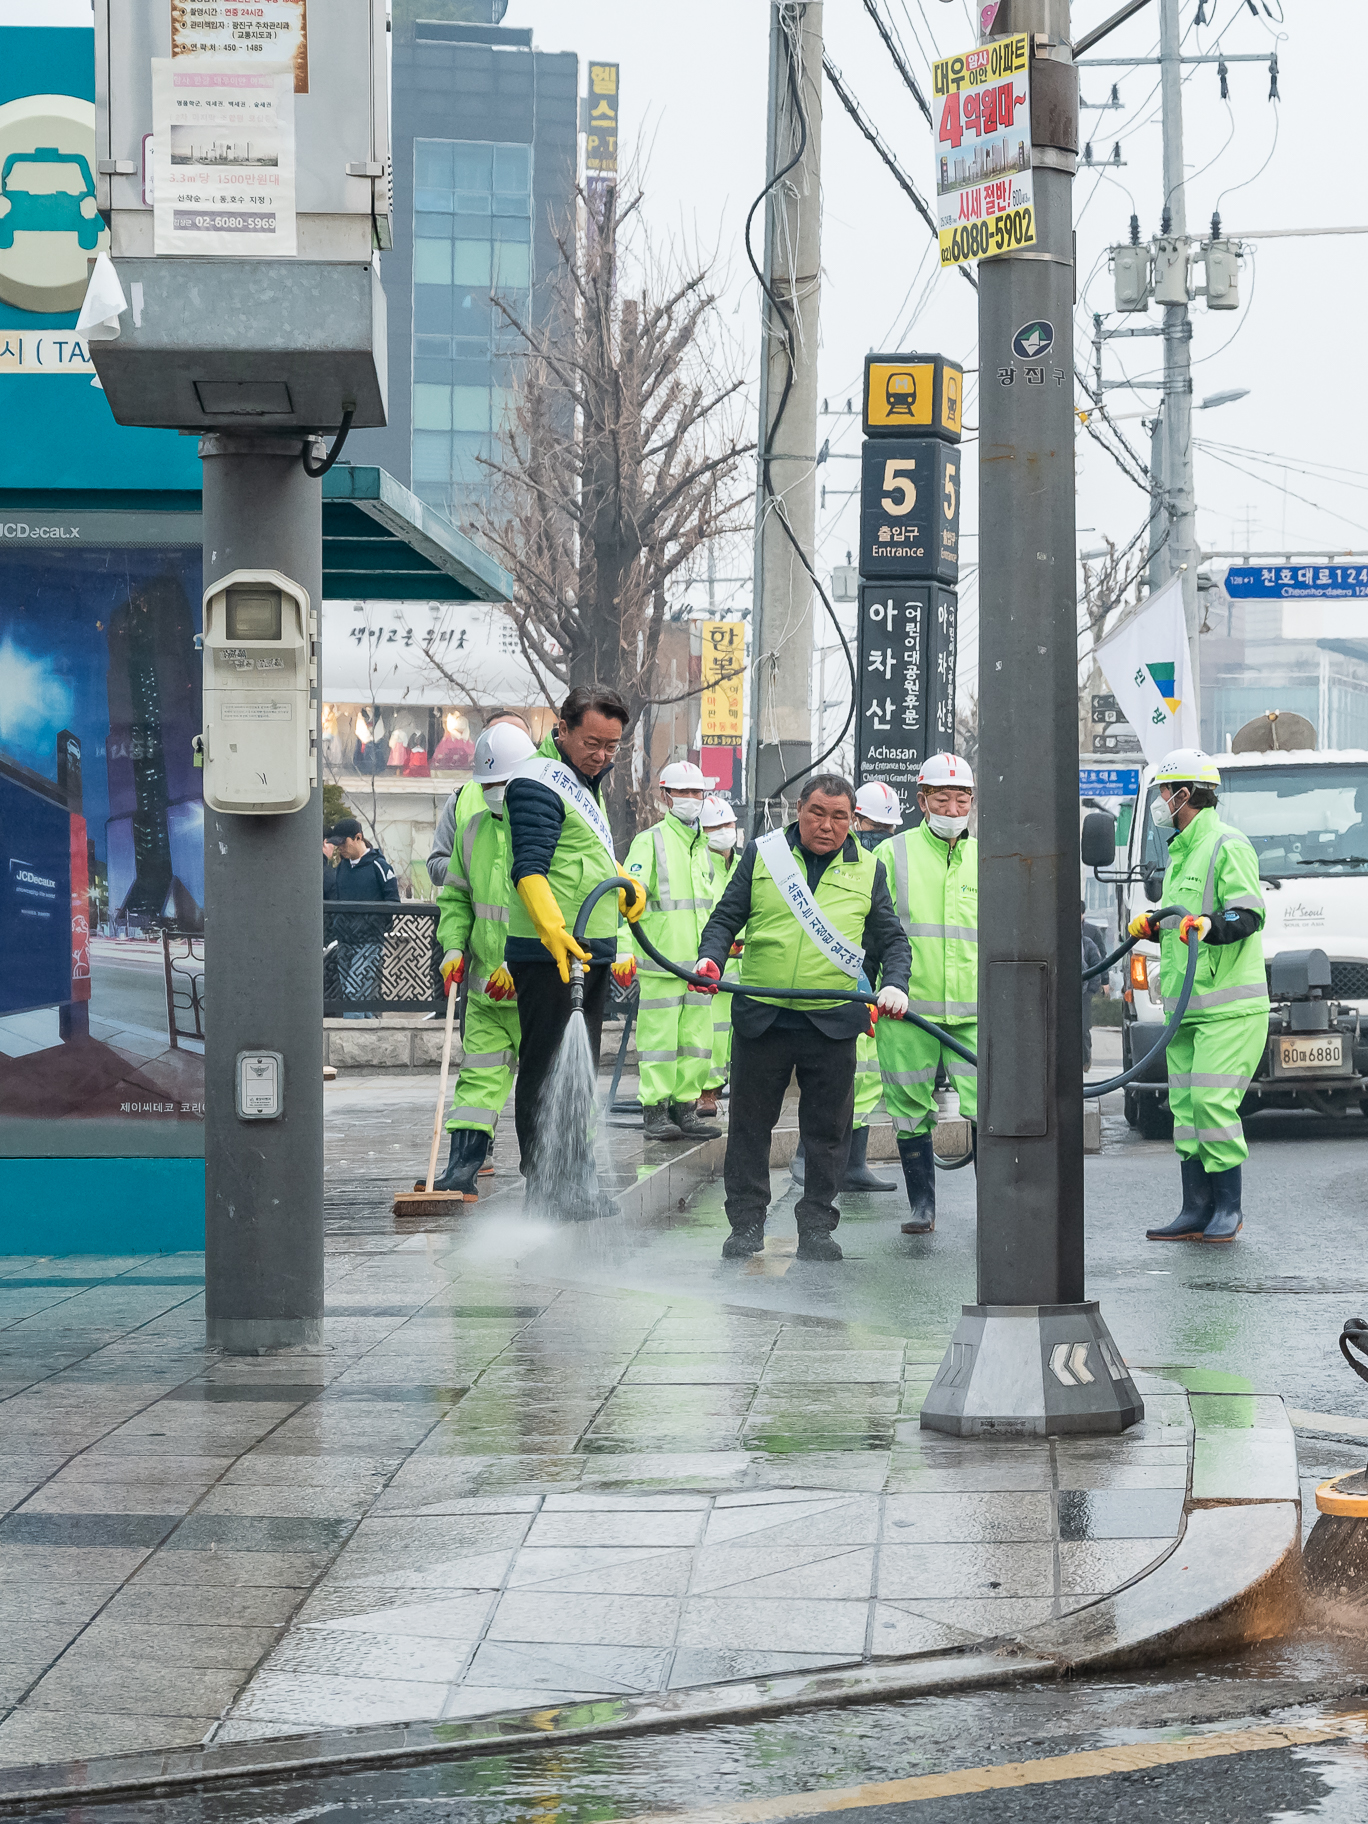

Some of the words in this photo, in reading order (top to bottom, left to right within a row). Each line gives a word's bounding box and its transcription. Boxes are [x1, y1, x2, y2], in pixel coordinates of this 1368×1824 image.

[190, 8, 217, 16] 촬영시간
[241, 8, 264, 17] 24시간
[255, 22, 290, 30] 주차관리과
[968, 51, 987, 69] 암사
[991, 37, 1025, 77] 아파트
[934, 57, 965, 95] 대우
[969, 67, 987, 85] 이안
[217, 174, 280, 186] 1500만원대
[958, 188, 981, 221] 시세
[984, 179, 1012, 216] 절반!
[195, 216, 276, 229] 02-6080-5969
[0, 338, 22, 364] 시
[996, 366, 1067, 387] 광진구
[881, 459, 917, 516] 5
[943, 463, 956, 520] 5
[877, 526, 919, 541] 출입구
[872, 545, 924, 557] Entrance
[866, 600, 897, 730] 아차산
[868, 745, 917, 759] Achasan
[890, 774, 906, 782] Grand
[16, 870, 56, 888] JCDecaux
[788, 882, 814, 919] 쓰레기는
[809, 916, 835, 945] 지정된
[120, 1102, 174, 1113] 제이씨데코
[180, 1103, 205, 1113] 코리
